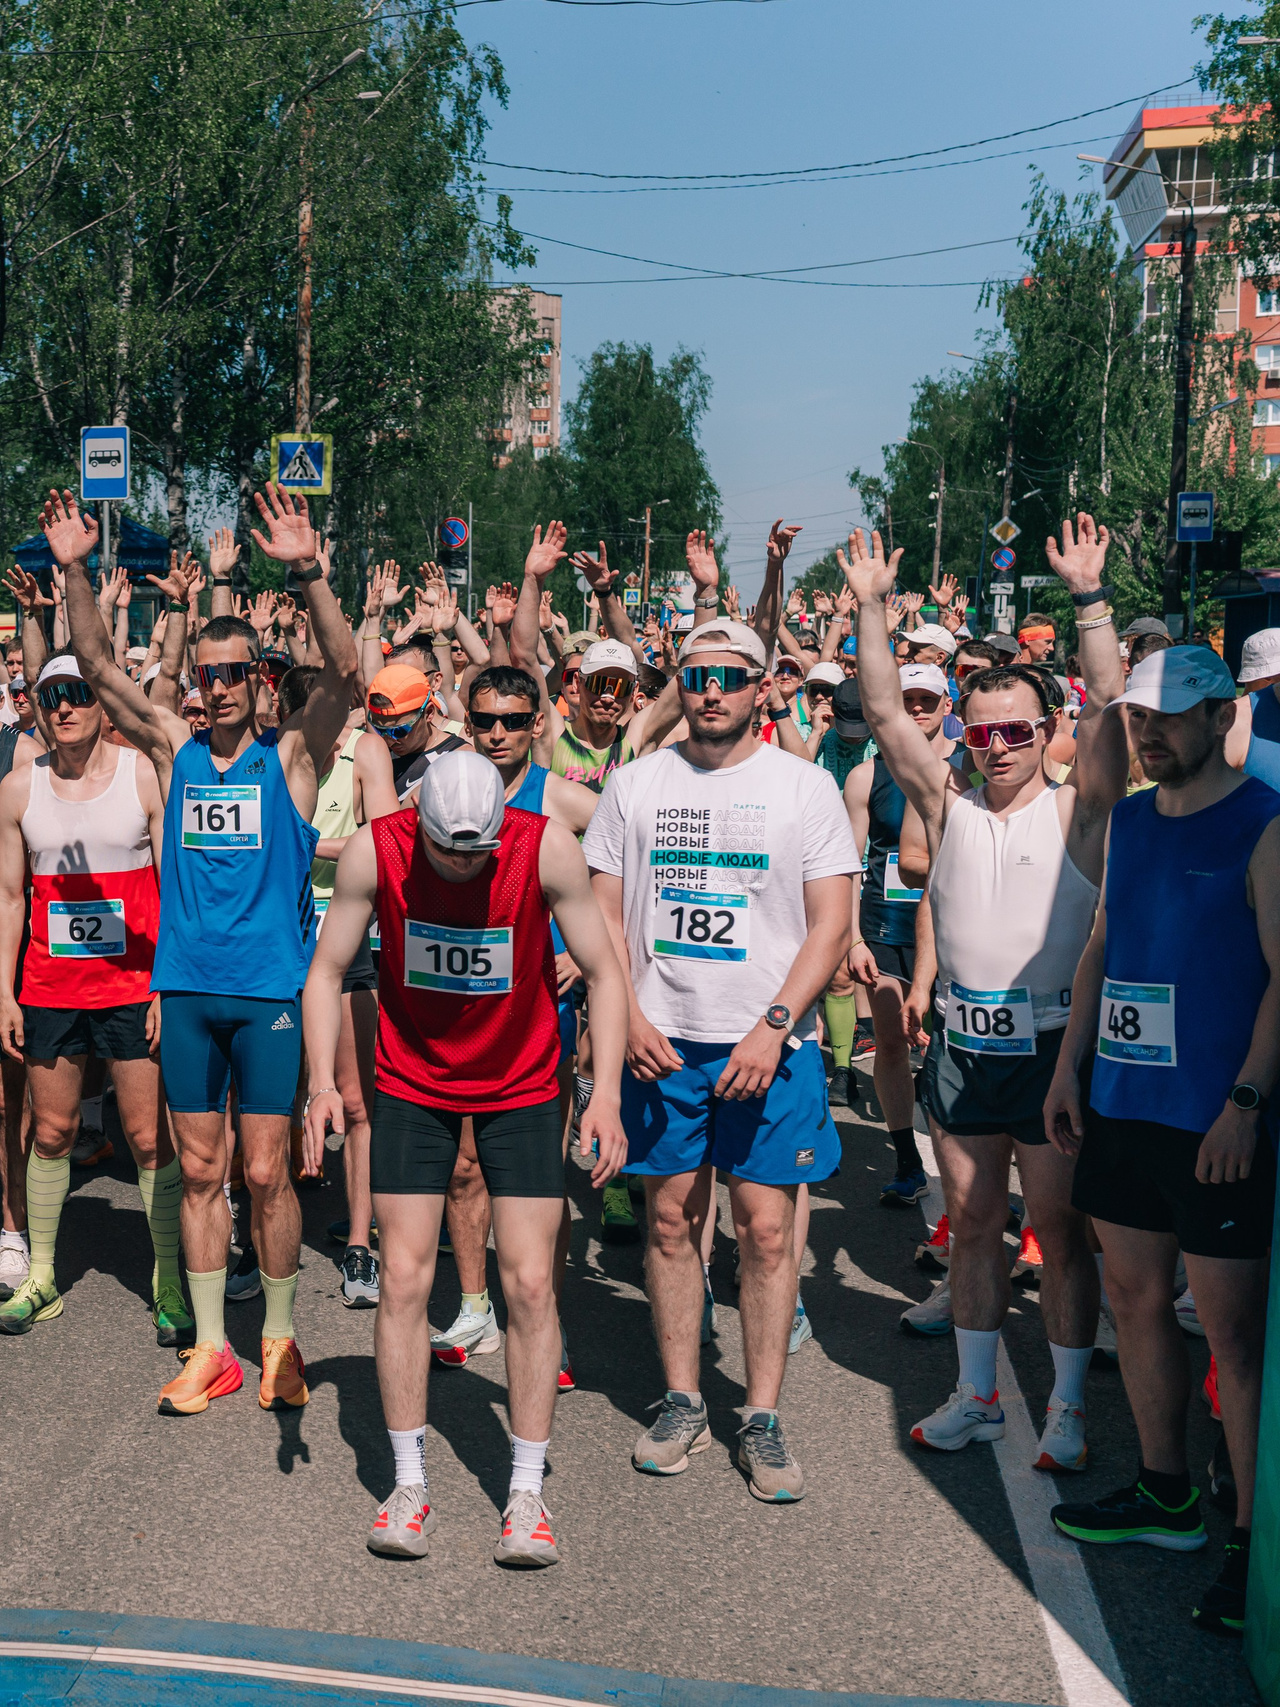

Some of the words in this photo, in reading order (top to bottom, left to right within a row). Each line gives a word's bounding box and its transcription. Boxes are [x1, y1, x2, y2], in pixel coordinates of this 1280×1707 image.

[192, 803, 240, 832] 161
[656, 808, 710, 821] НОВЫЕ
[713, 810, 766, 823] ЛЮДИ
[655, 822, 710, 834] НОВЫЕ
[712, 824, 765, 837] ЛЮДИ
[229, 835, 249, 843] СЕРГЕЙ
[655, 836, 709, 849] НОВЫЕ
[712, 838, 765, 851] ЛЮДИ
[654, 851, 712, 865] НОВЫЕ
[715, 854, 763, 868] ЛЮДИ
[654, 868, 708, 880] НОВЫЕ
[711, 869, 763, 883] ЛЮДИ
[69, 916, 103, 942] 62
[670, 906, 735, 944] 182
[425, 944, 492, 976] 105
[271, 1022, 294, 1031] adidas
[956, 1003, 1015, 1037] 108
[1108, 1003, 1141, 1041] 48
[1123, 1047, 1159, 1056] АЛЕКСАНДР
